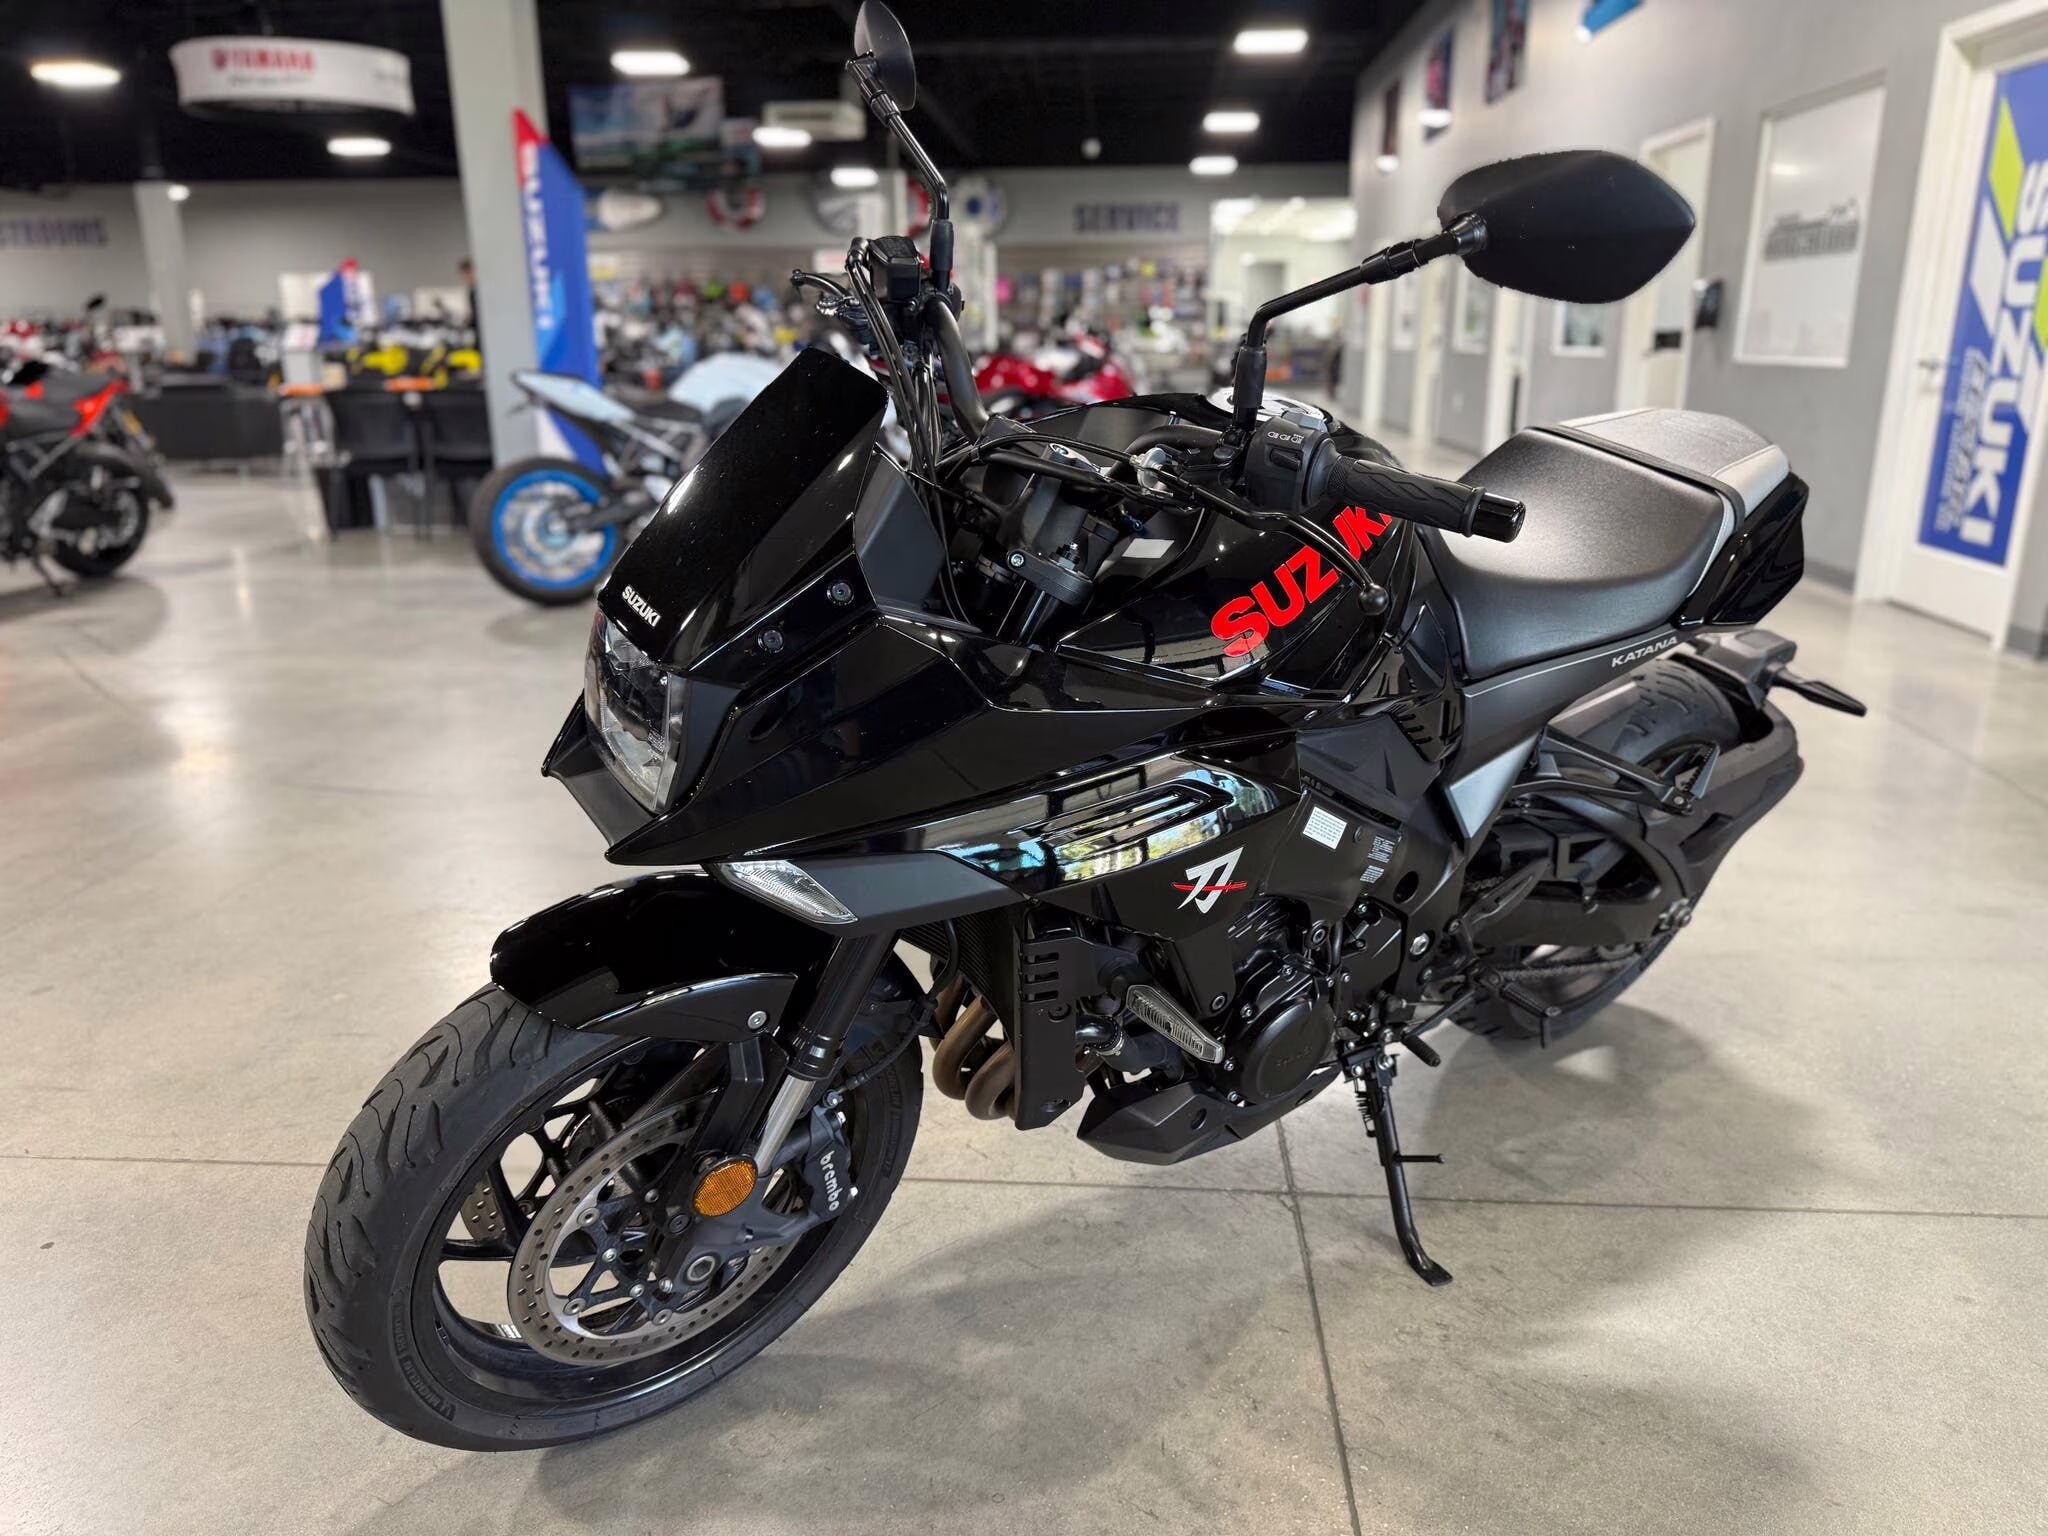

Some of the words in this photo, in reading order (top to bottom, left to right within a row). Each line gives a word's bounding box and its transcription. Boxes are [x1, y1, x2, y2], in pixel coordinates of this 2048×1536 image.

[232, 48, 316, 72] YAMAHA
[1074, 202, 1179, 232] SERVICE
[1211, 505, 1393, 657] SUZK
[621, 585, 661, 627] SUZUKI
[1611, 636, 1678, 668] KATANA
[820, 1150, 843, 1212] brembo
